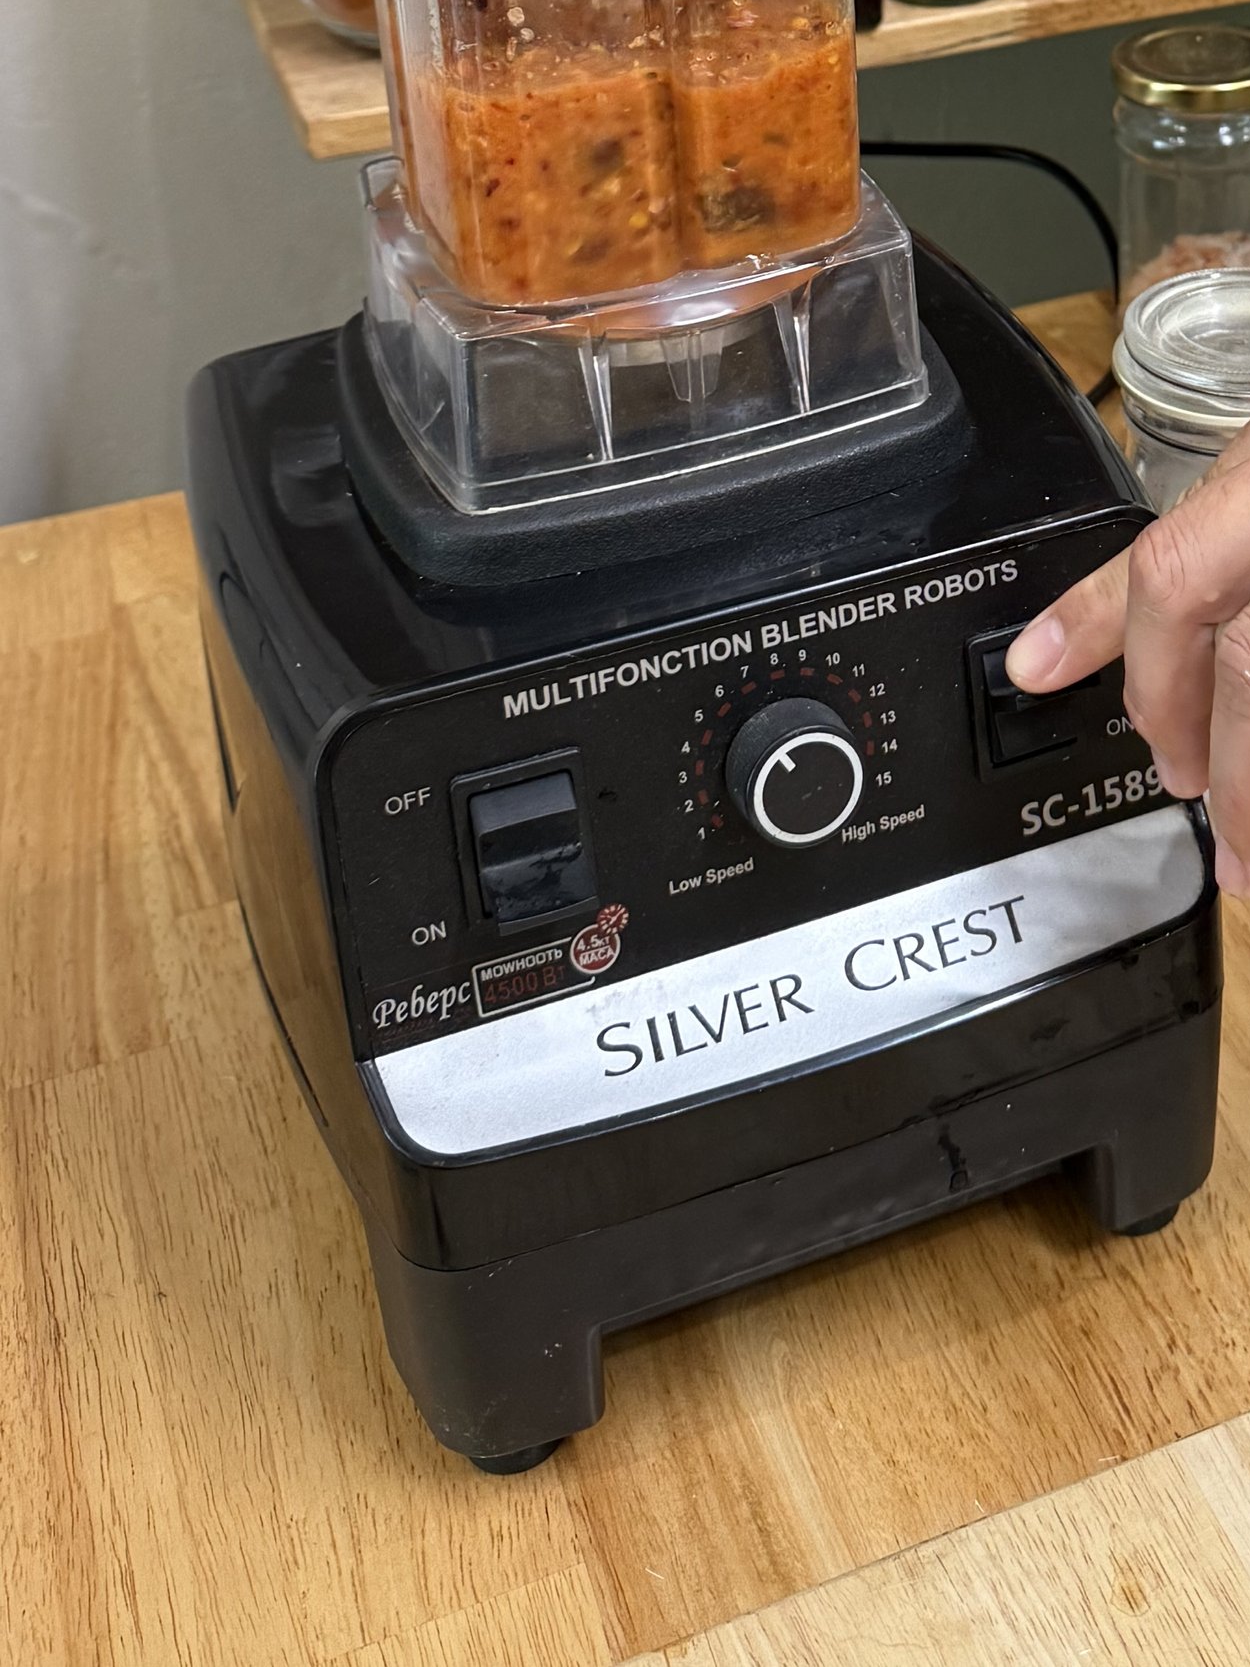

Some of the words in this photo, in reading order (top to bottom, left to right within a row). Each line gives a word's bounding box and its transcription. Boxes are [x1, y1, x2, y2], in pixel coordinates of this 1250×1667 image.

[503, 630, 753, 719] MULTIFONCTION
[761, 592, 897, 650] BLENDER
[903, 559, 1019, 610] ROBOTS
[769, 653, 779, 665] 8
[799, 649, 807, 662] 9
[825, 652, 841, 667] 10
[740, 665, 750, 679] 7
[852, 663, 866, 678] 11
[715, 684, 725, 698] 6
[869, 683, 886, 698] 12
[694, 709, 704, 723] 5
[880, 710, 897, 725] 13
[681, 740, 691, 754] 4
[881, 738, 898, 754] 14
[678, 771, 688, 784] 3
[875, 771, 892, 787] 15
[384, 786, 431, 815] OFF
[684, 799, 694, 813] 2
[1020, 764, 1163, 835] SC-1589
[840, 818, 876, 844] High
[879, 804, 926, 832] Speed
[697, 827, 706, 840] 1
[668, 873, 702, 896] Low
[705, 856, 755, 887] Speed
[411, 920, 447, 946] ON
[484, 969, 540, 1005] 4500
[596, 973, 816, 1077] SILVER
[843, 895, 1026, 992] CREST
